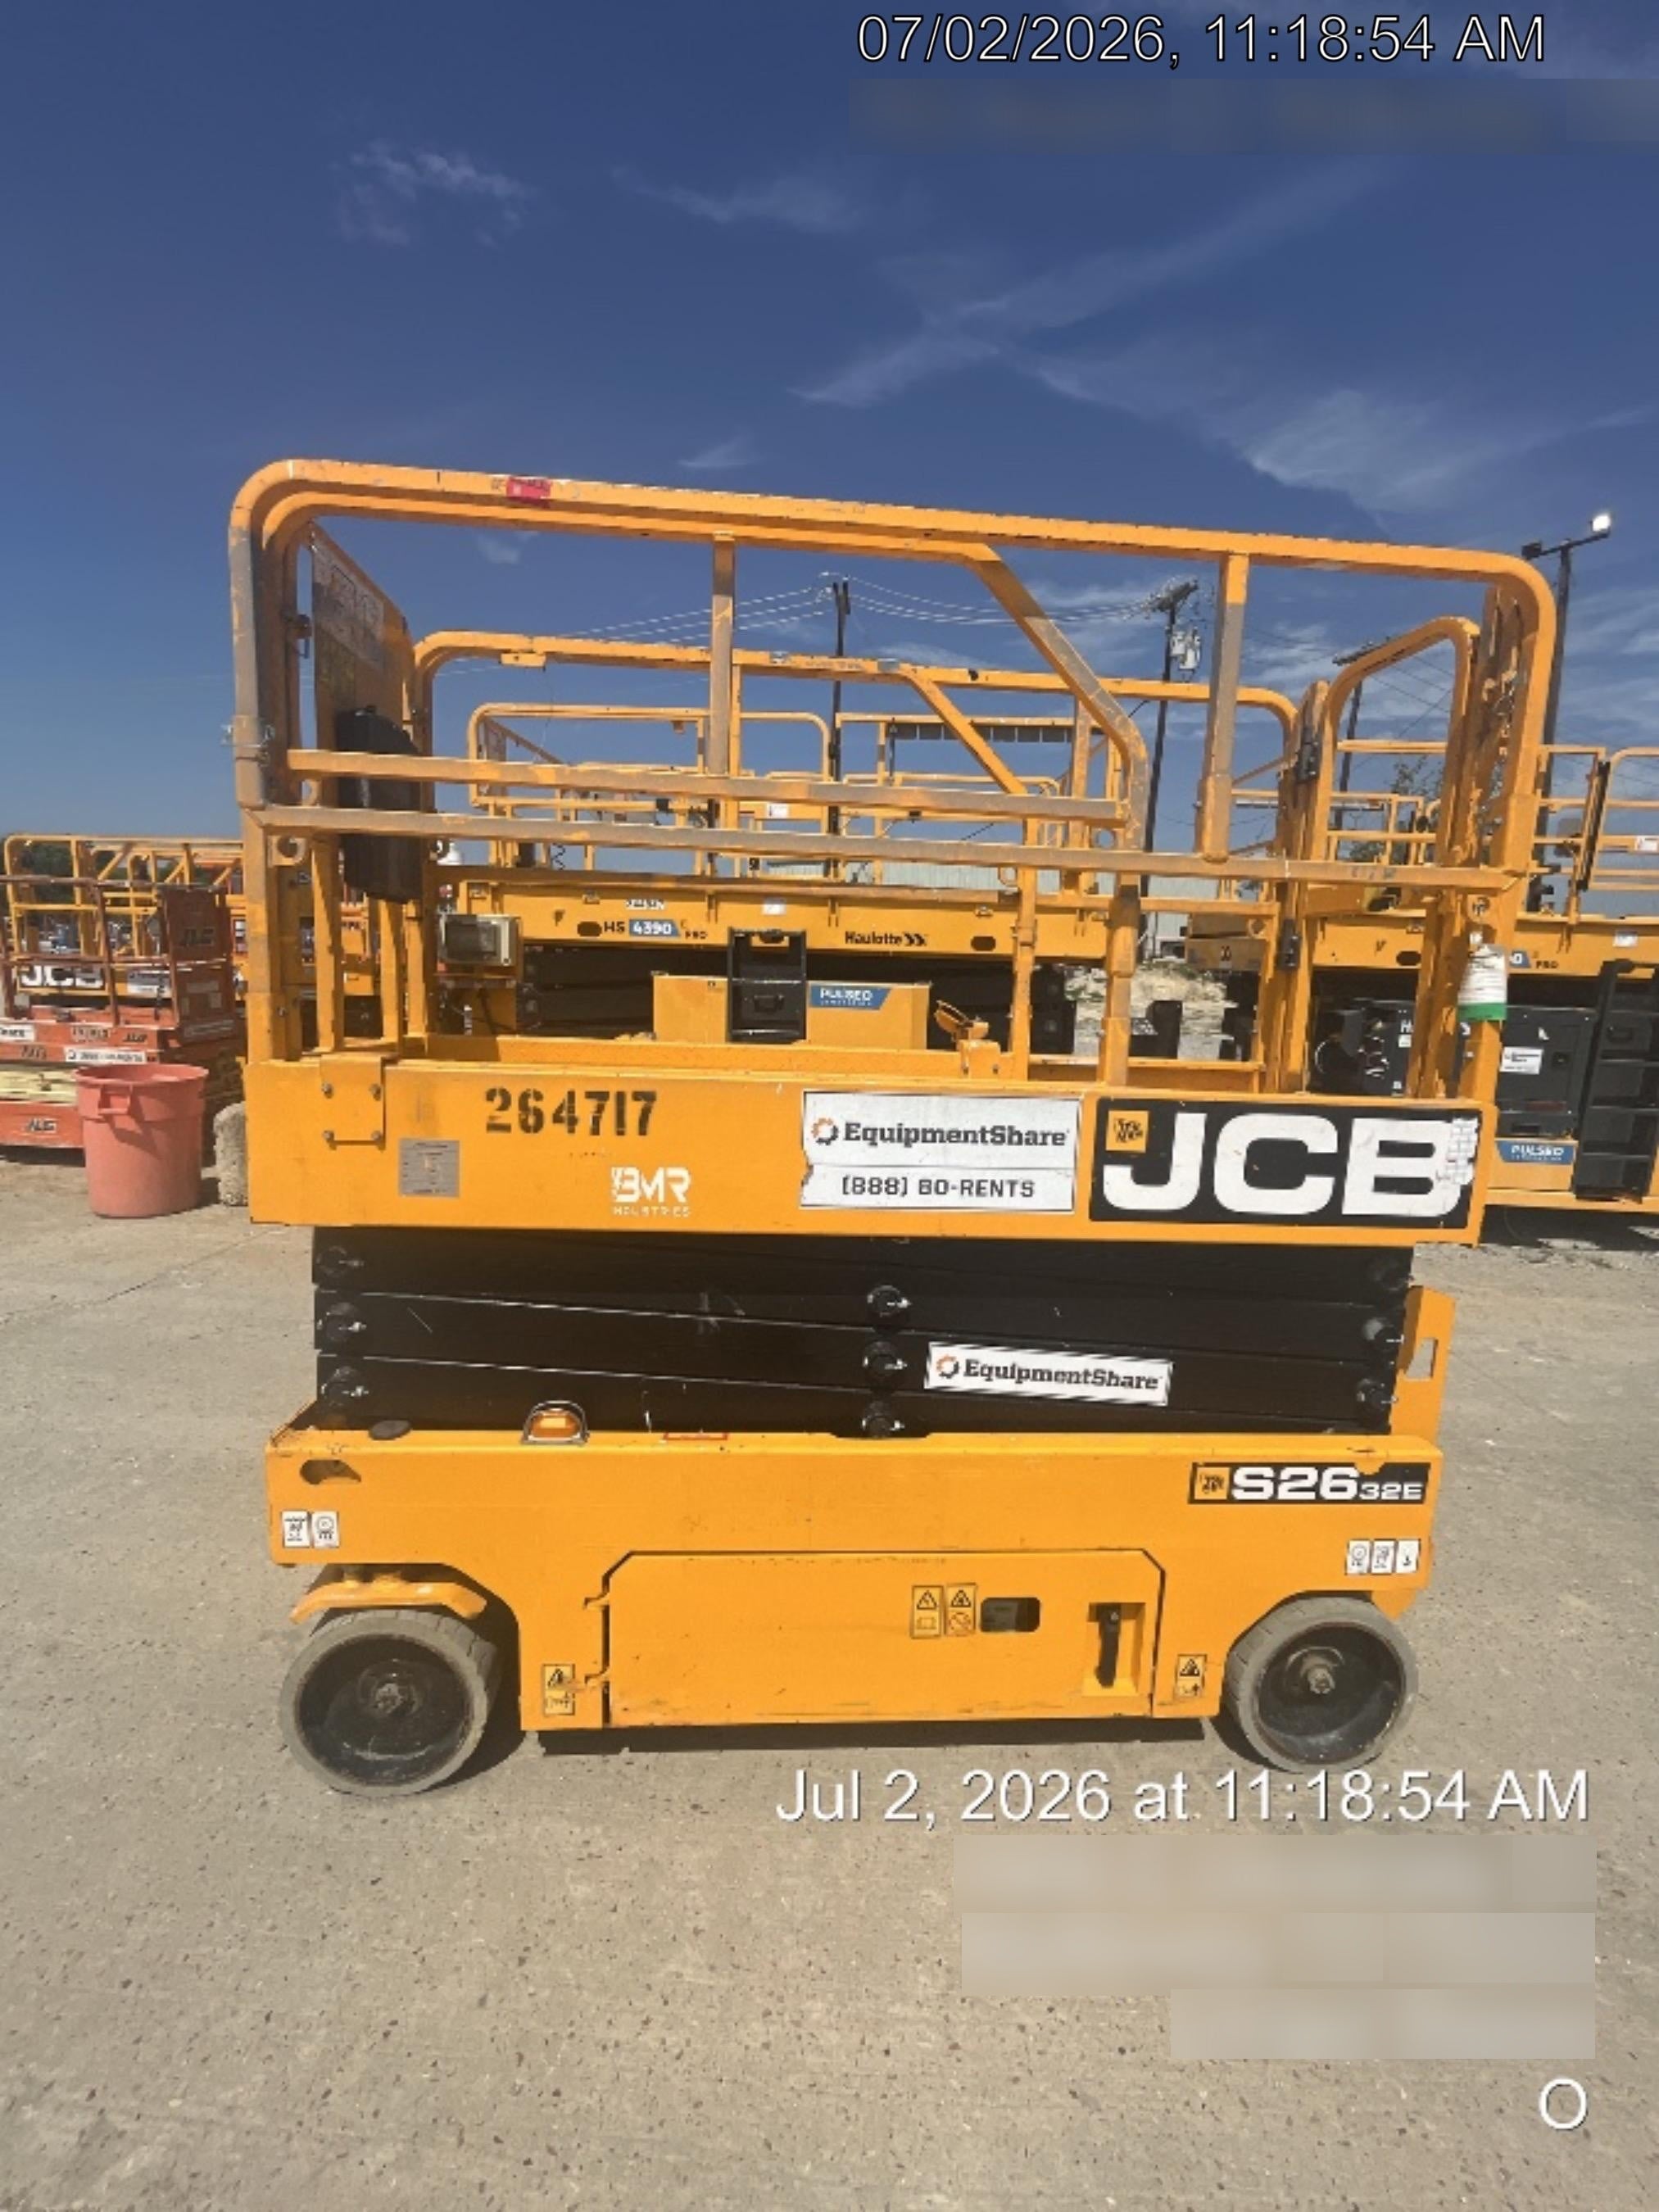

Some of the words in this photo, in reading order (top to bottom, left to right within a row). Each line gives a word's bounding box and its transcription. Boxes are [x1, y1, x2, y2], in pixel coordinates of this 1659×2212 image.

[633, 920, 672, 935] 4390
[845, 931, 902, 945] Haulotte
[20, 964, 105, 987] JCB
[486, 1086, 657, 1136] 264717
[845, 1122, 1066, 1148] EquipmentShare
[1103, 1112, 1475, 1217] JCB
[610, 1166, 691, 1203] BMR
[842, 1175, 908, 1197] (888)
[918, 1178, 1035, 1199] 80-RENTS
[963, 1358, 1159, 1391] EquipmentShare
[1231, 1466, 1360, 1501] S26
[1358, 1481, 1425, 1501] 32E
